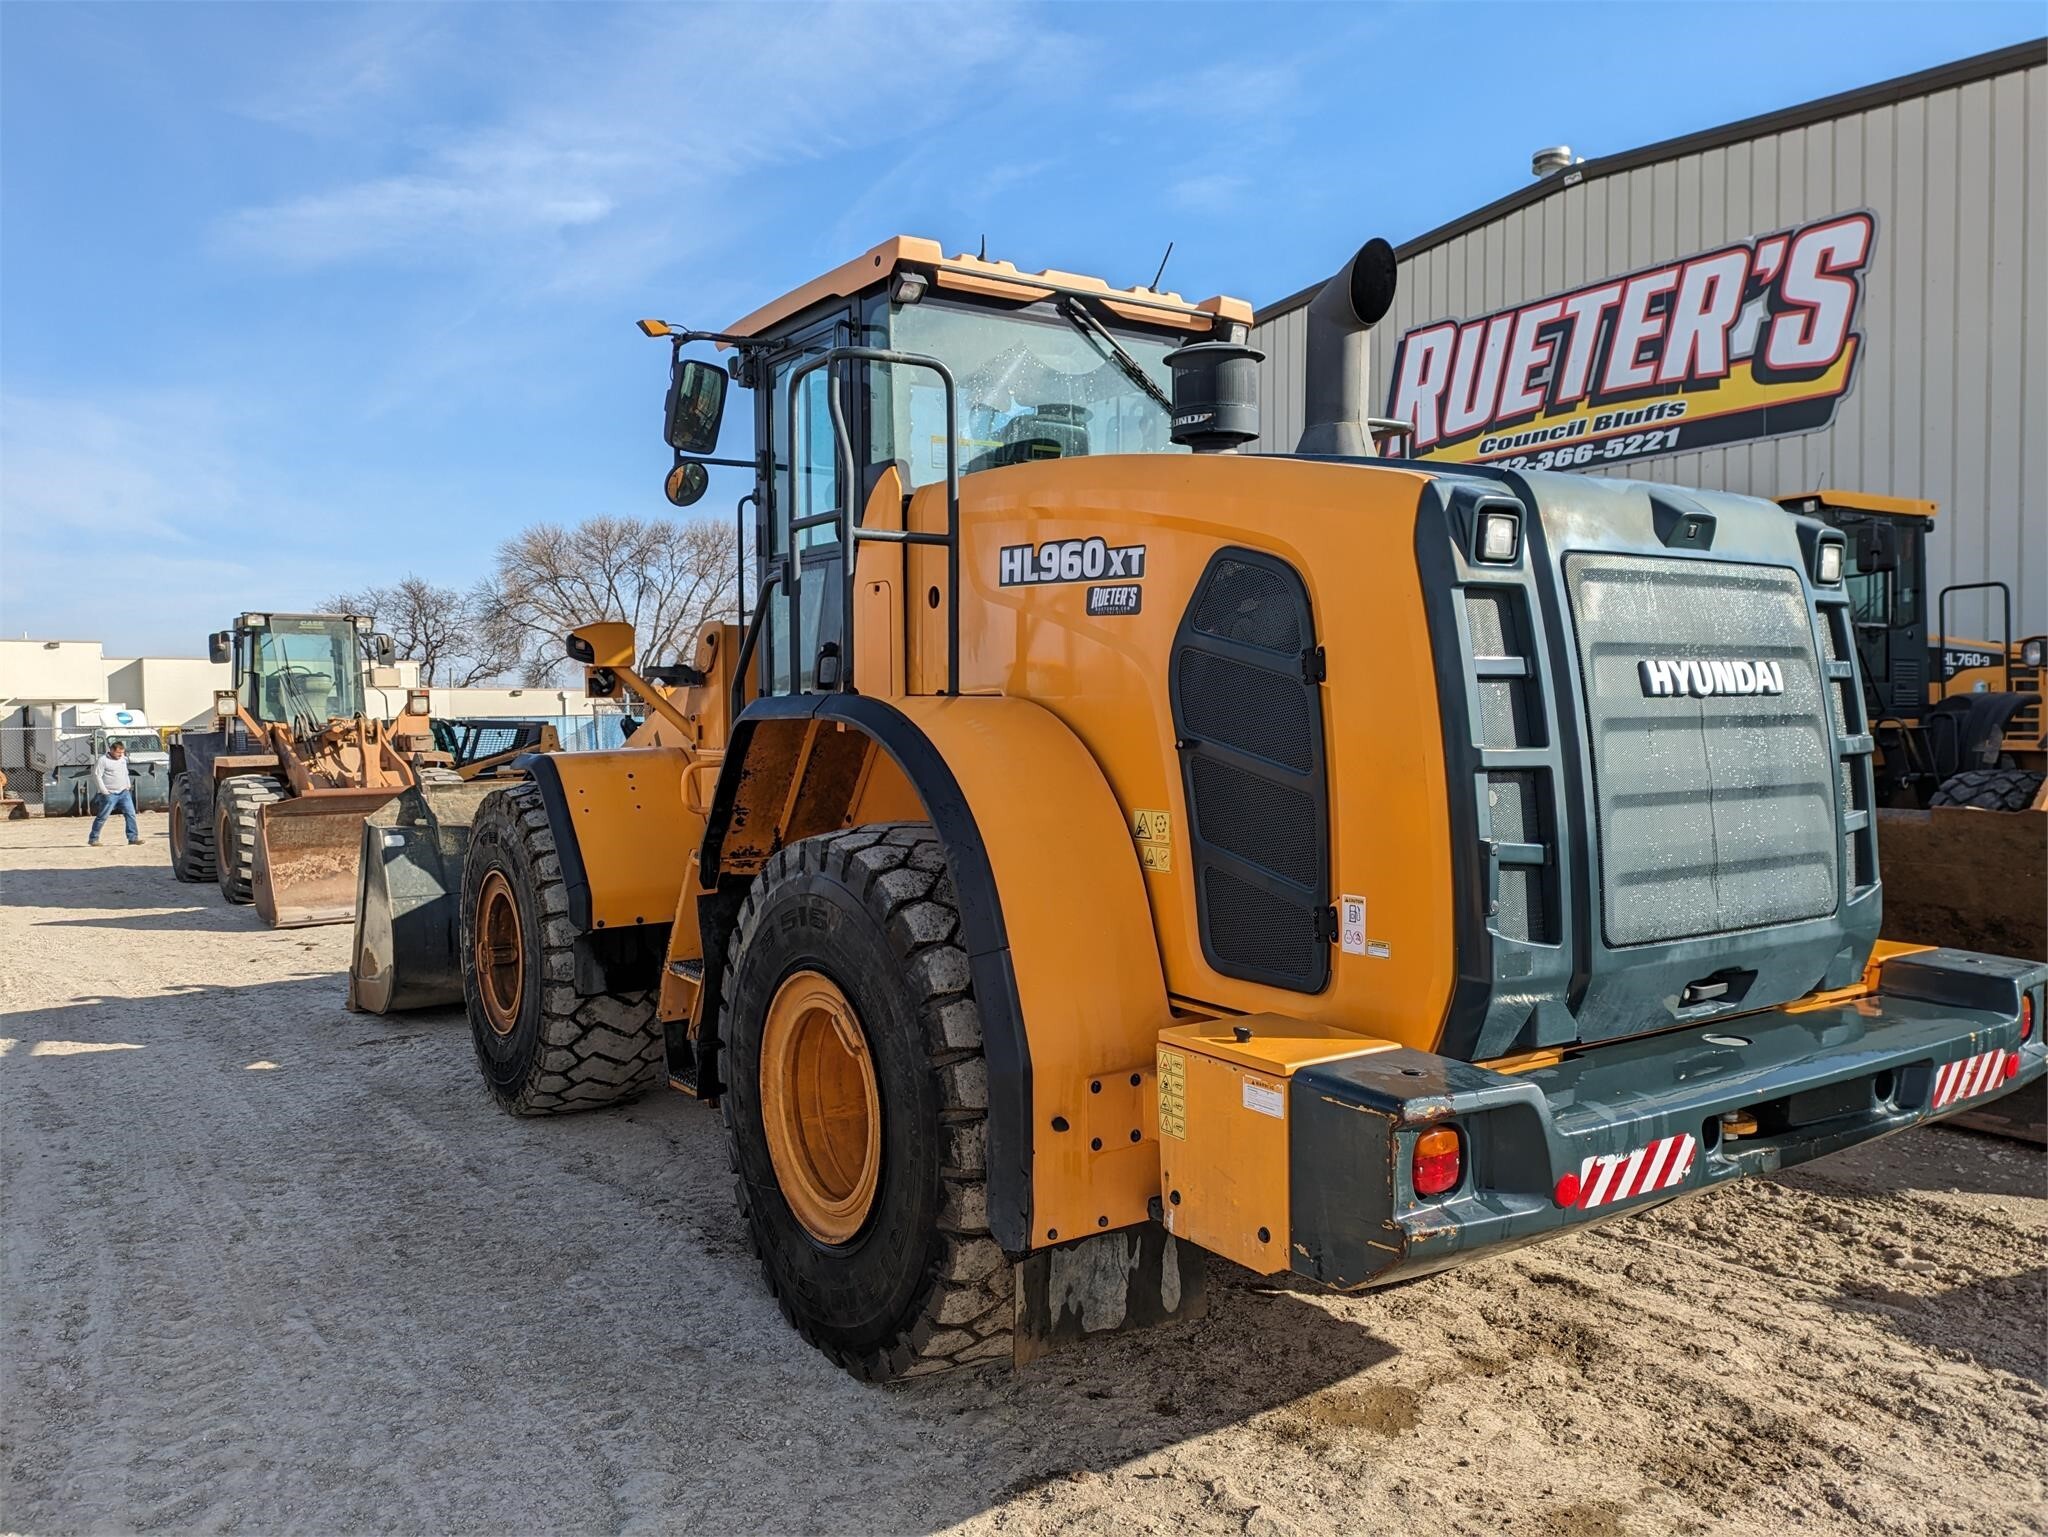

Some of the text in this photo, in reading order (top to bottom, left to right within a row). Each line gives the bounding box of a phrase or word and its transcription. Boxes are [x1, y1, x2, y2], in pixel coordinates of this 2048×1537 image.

[1386, 214, 1872, 458] RUETER'S
[1479, 401, 1686, 454] Council Bluffs
[1091, 586, 1138, 609] RUETER'S
[1645, 660, 1785, 696] HYUNDAI
